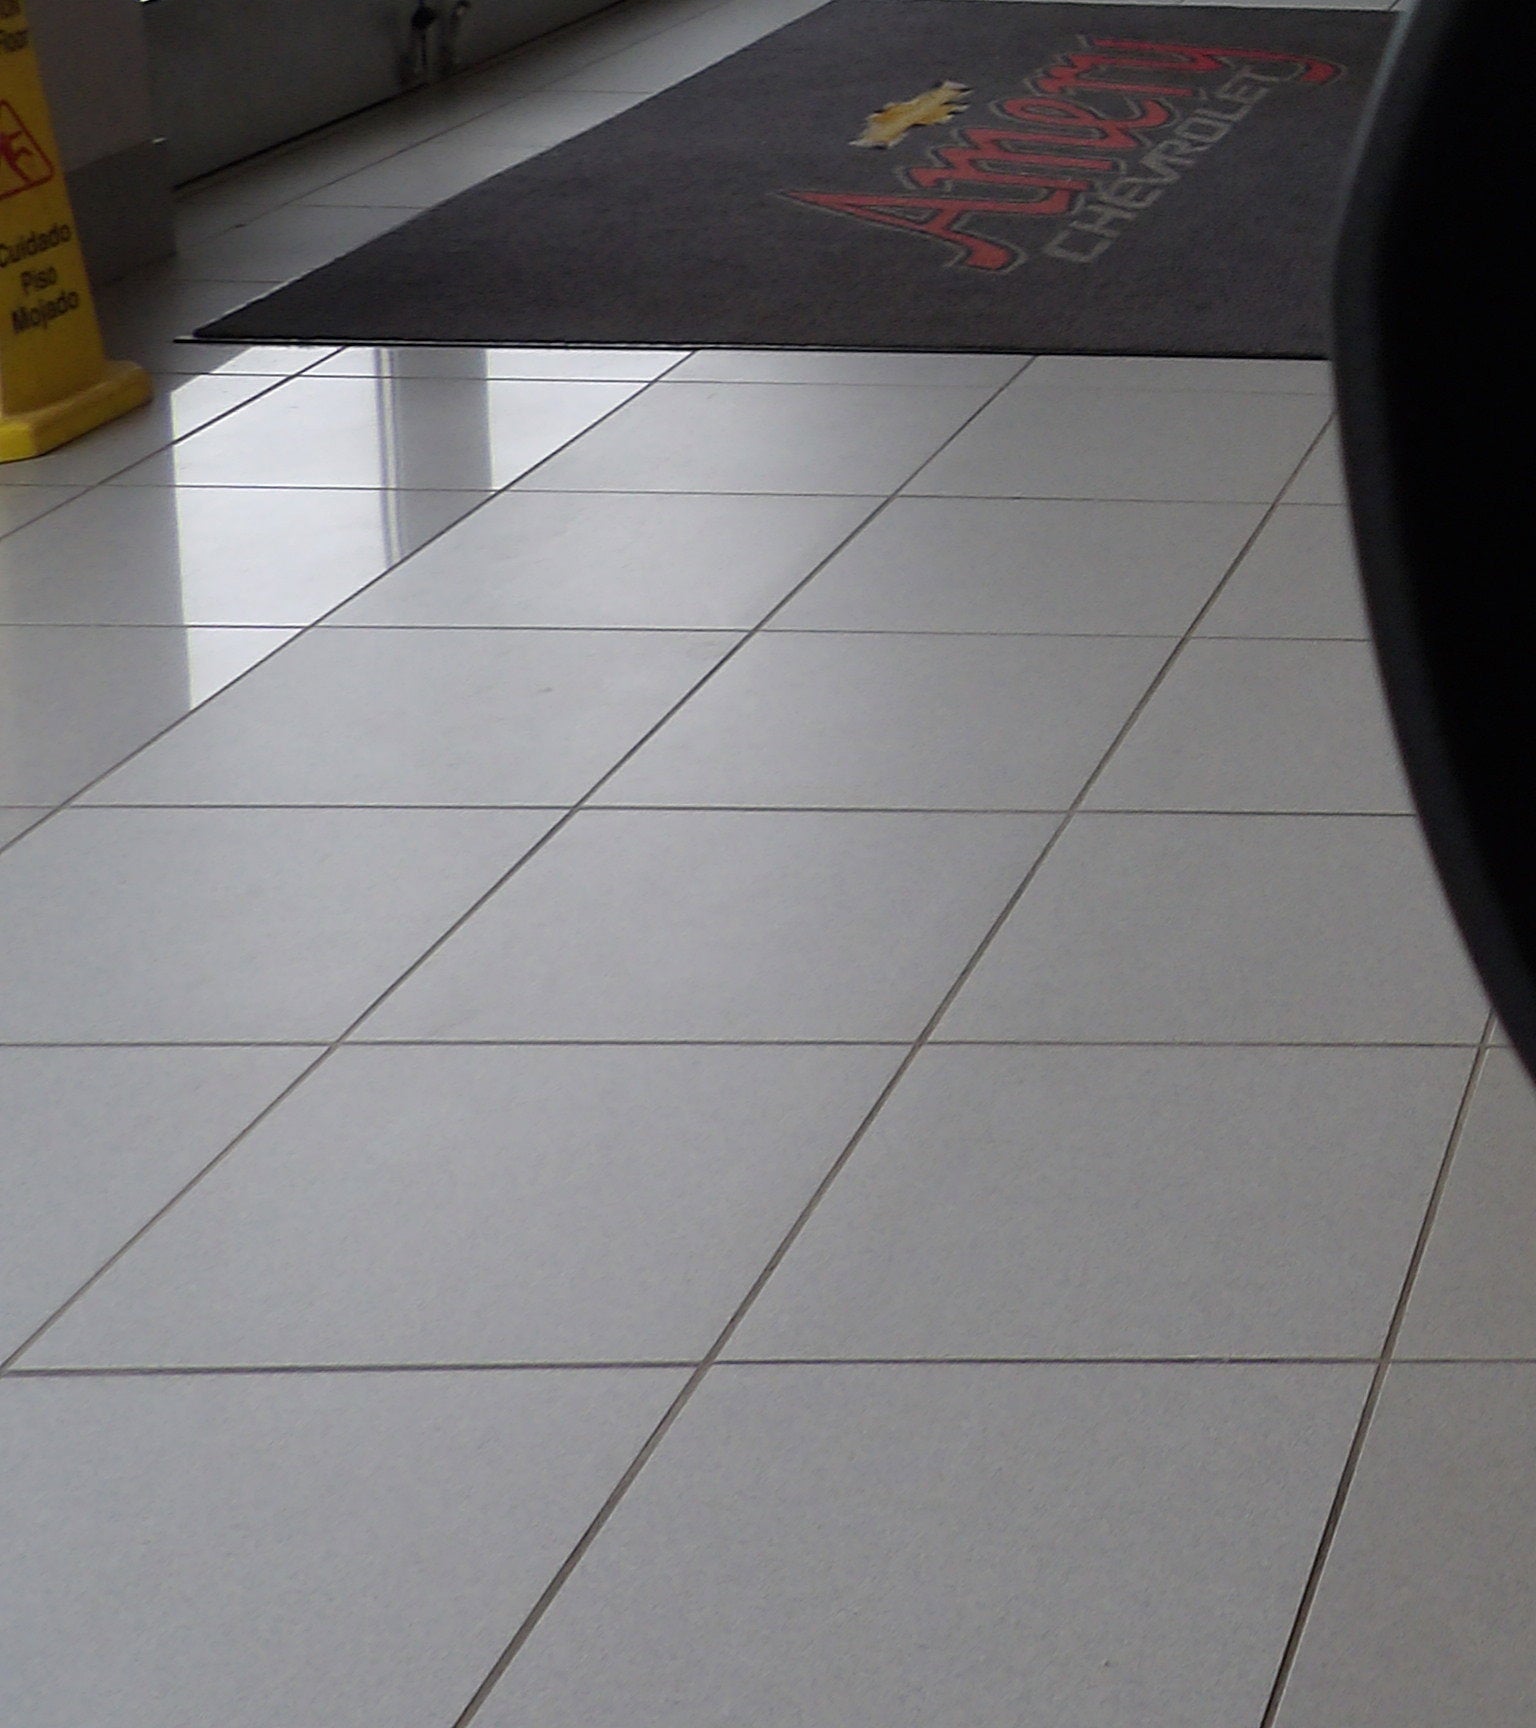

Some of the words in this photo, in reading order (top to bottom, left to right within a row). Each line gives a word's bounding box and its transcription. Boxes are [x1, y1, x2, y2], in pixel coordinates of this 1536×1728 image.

[770, 34, 1348, 273] Amery
[1043, 63, 1294, 265] CHEVROLET
[12, 290, 80, 334] Mojado
[21, 266, 57, 295] Piso
